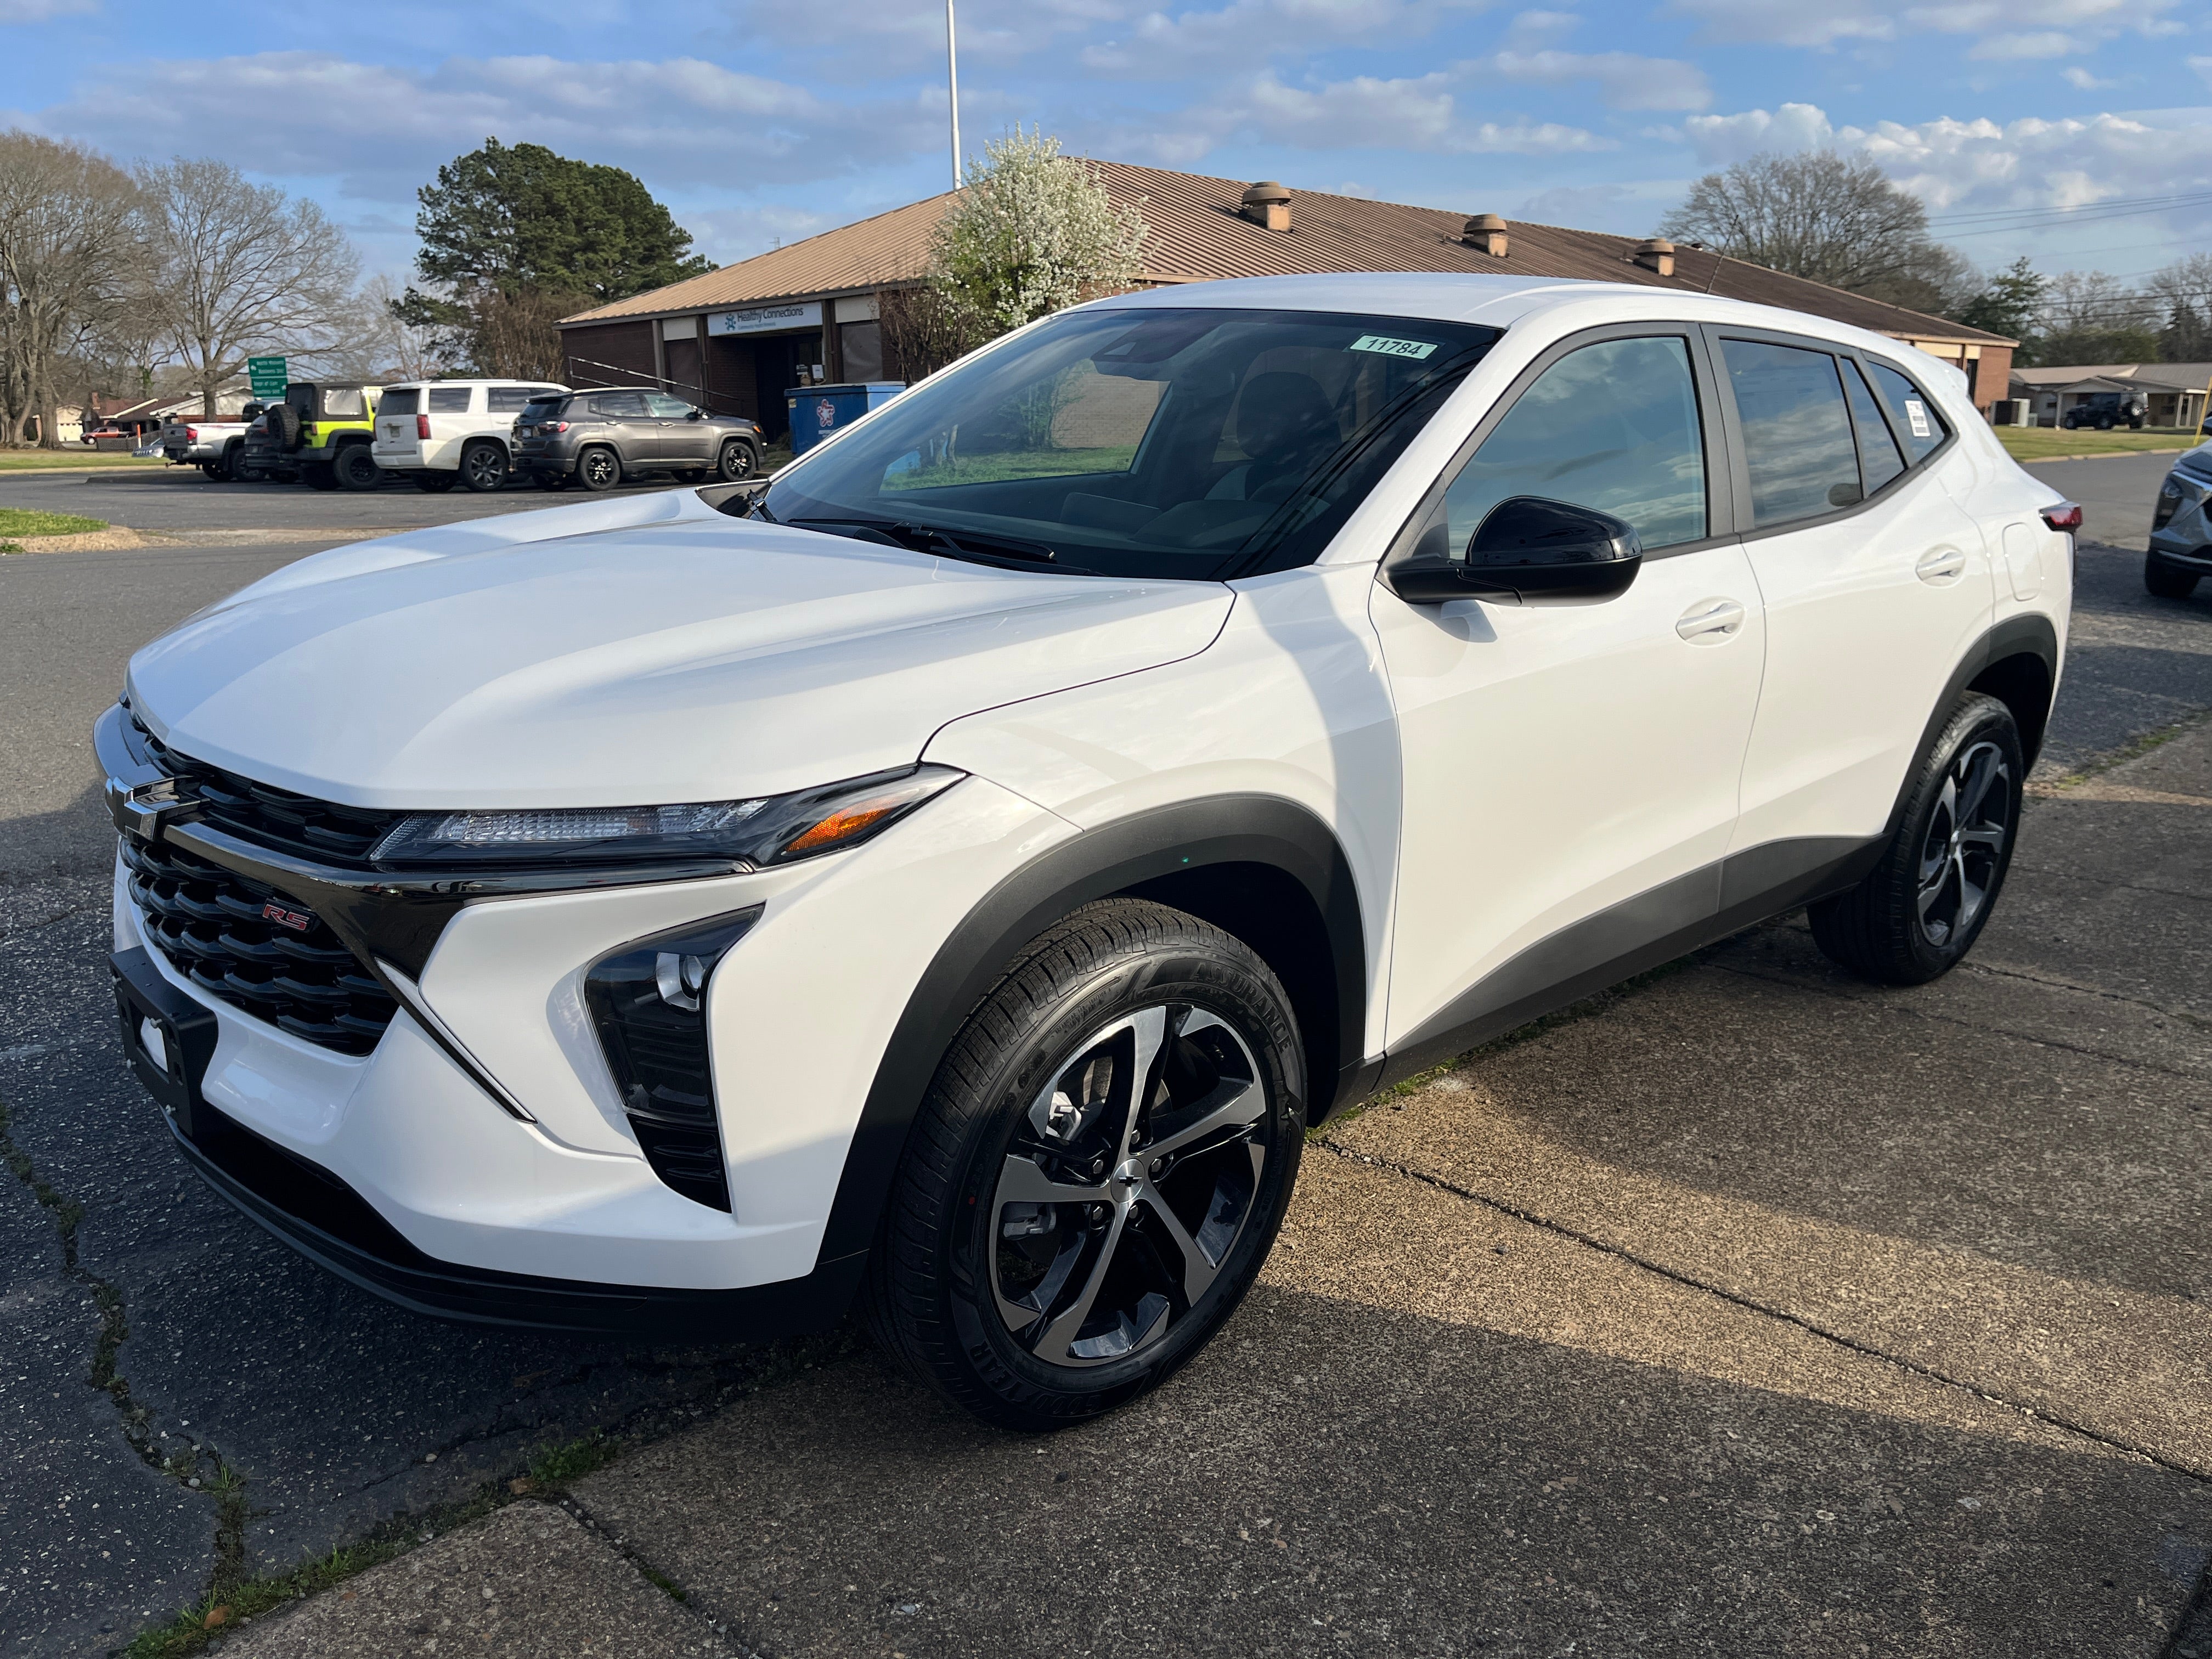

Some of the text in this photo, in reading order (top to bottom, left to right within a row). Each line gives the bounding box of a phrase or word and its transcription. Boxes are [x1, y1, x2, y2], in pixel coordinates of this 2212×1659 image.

[737, 306, 804, 323] Healthy Connections
[1366, 338, 1423, 355] 11784
[263, 904, 309, 930] RS
[1189, 961, 1292, 1054] ASSURANCE
[969, 1340, 1102, 1415] GOODYEAR
